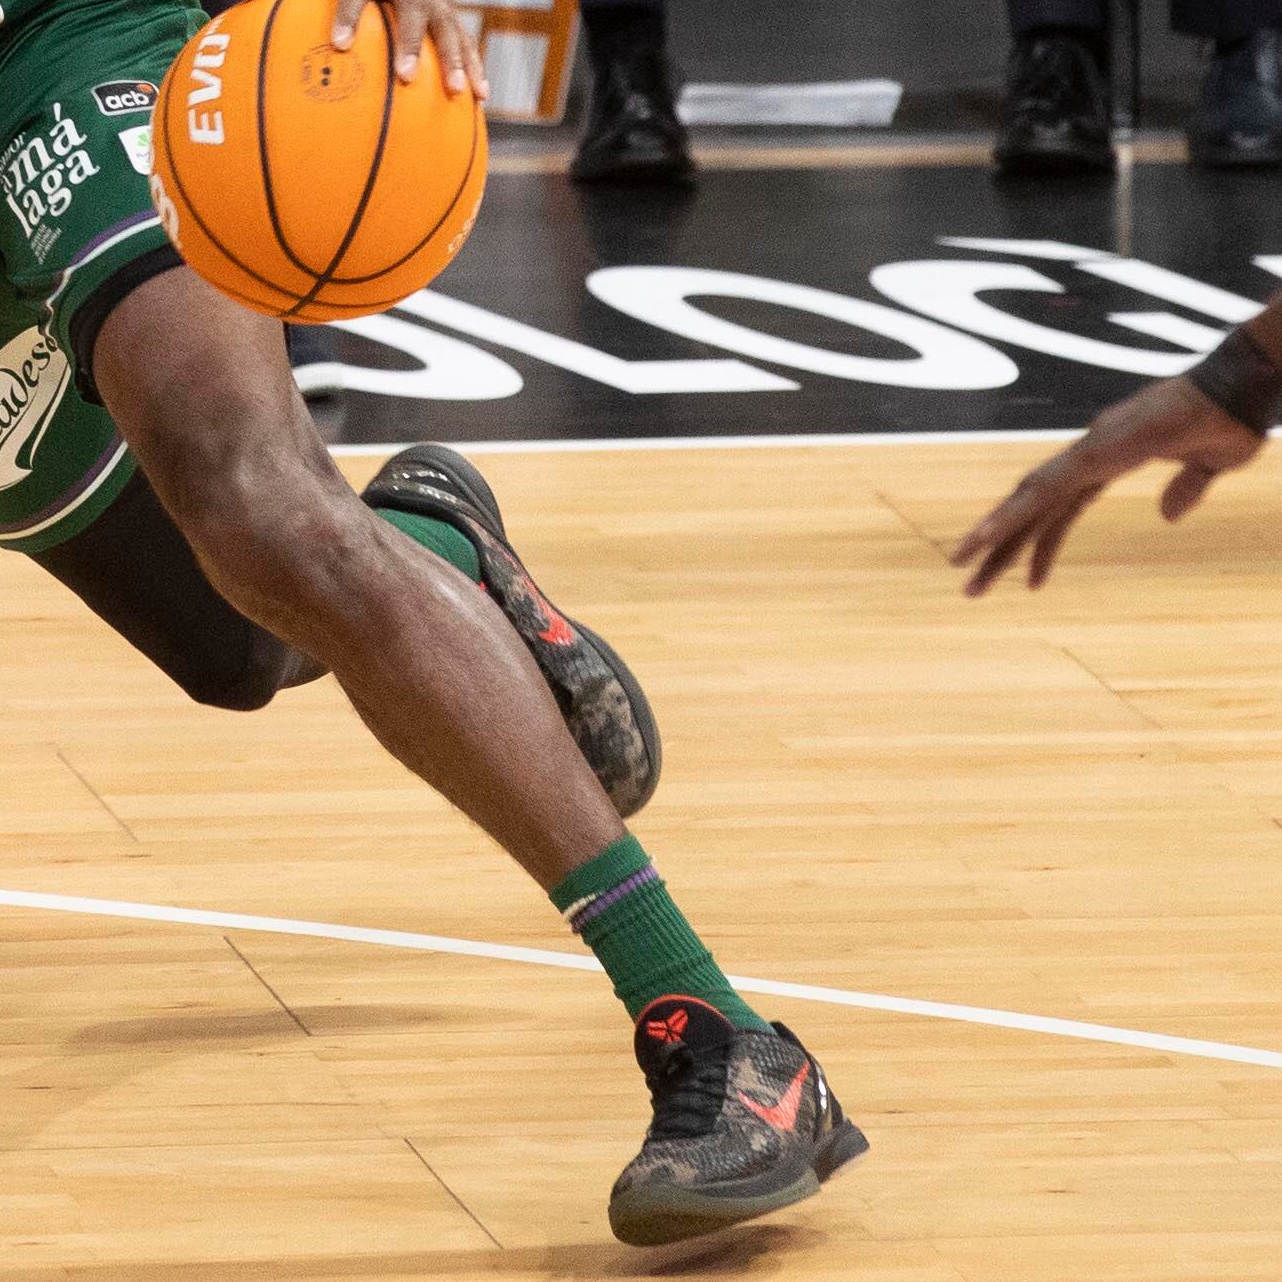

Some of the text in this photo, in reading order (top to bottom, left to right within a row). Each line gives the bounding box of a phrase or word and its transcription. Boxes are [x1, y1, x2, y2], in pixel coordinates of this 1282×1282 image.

[105, 90, 150, 110] acb
[6, 149, 101, 239] laga
[8, 102, 88, 197] má
